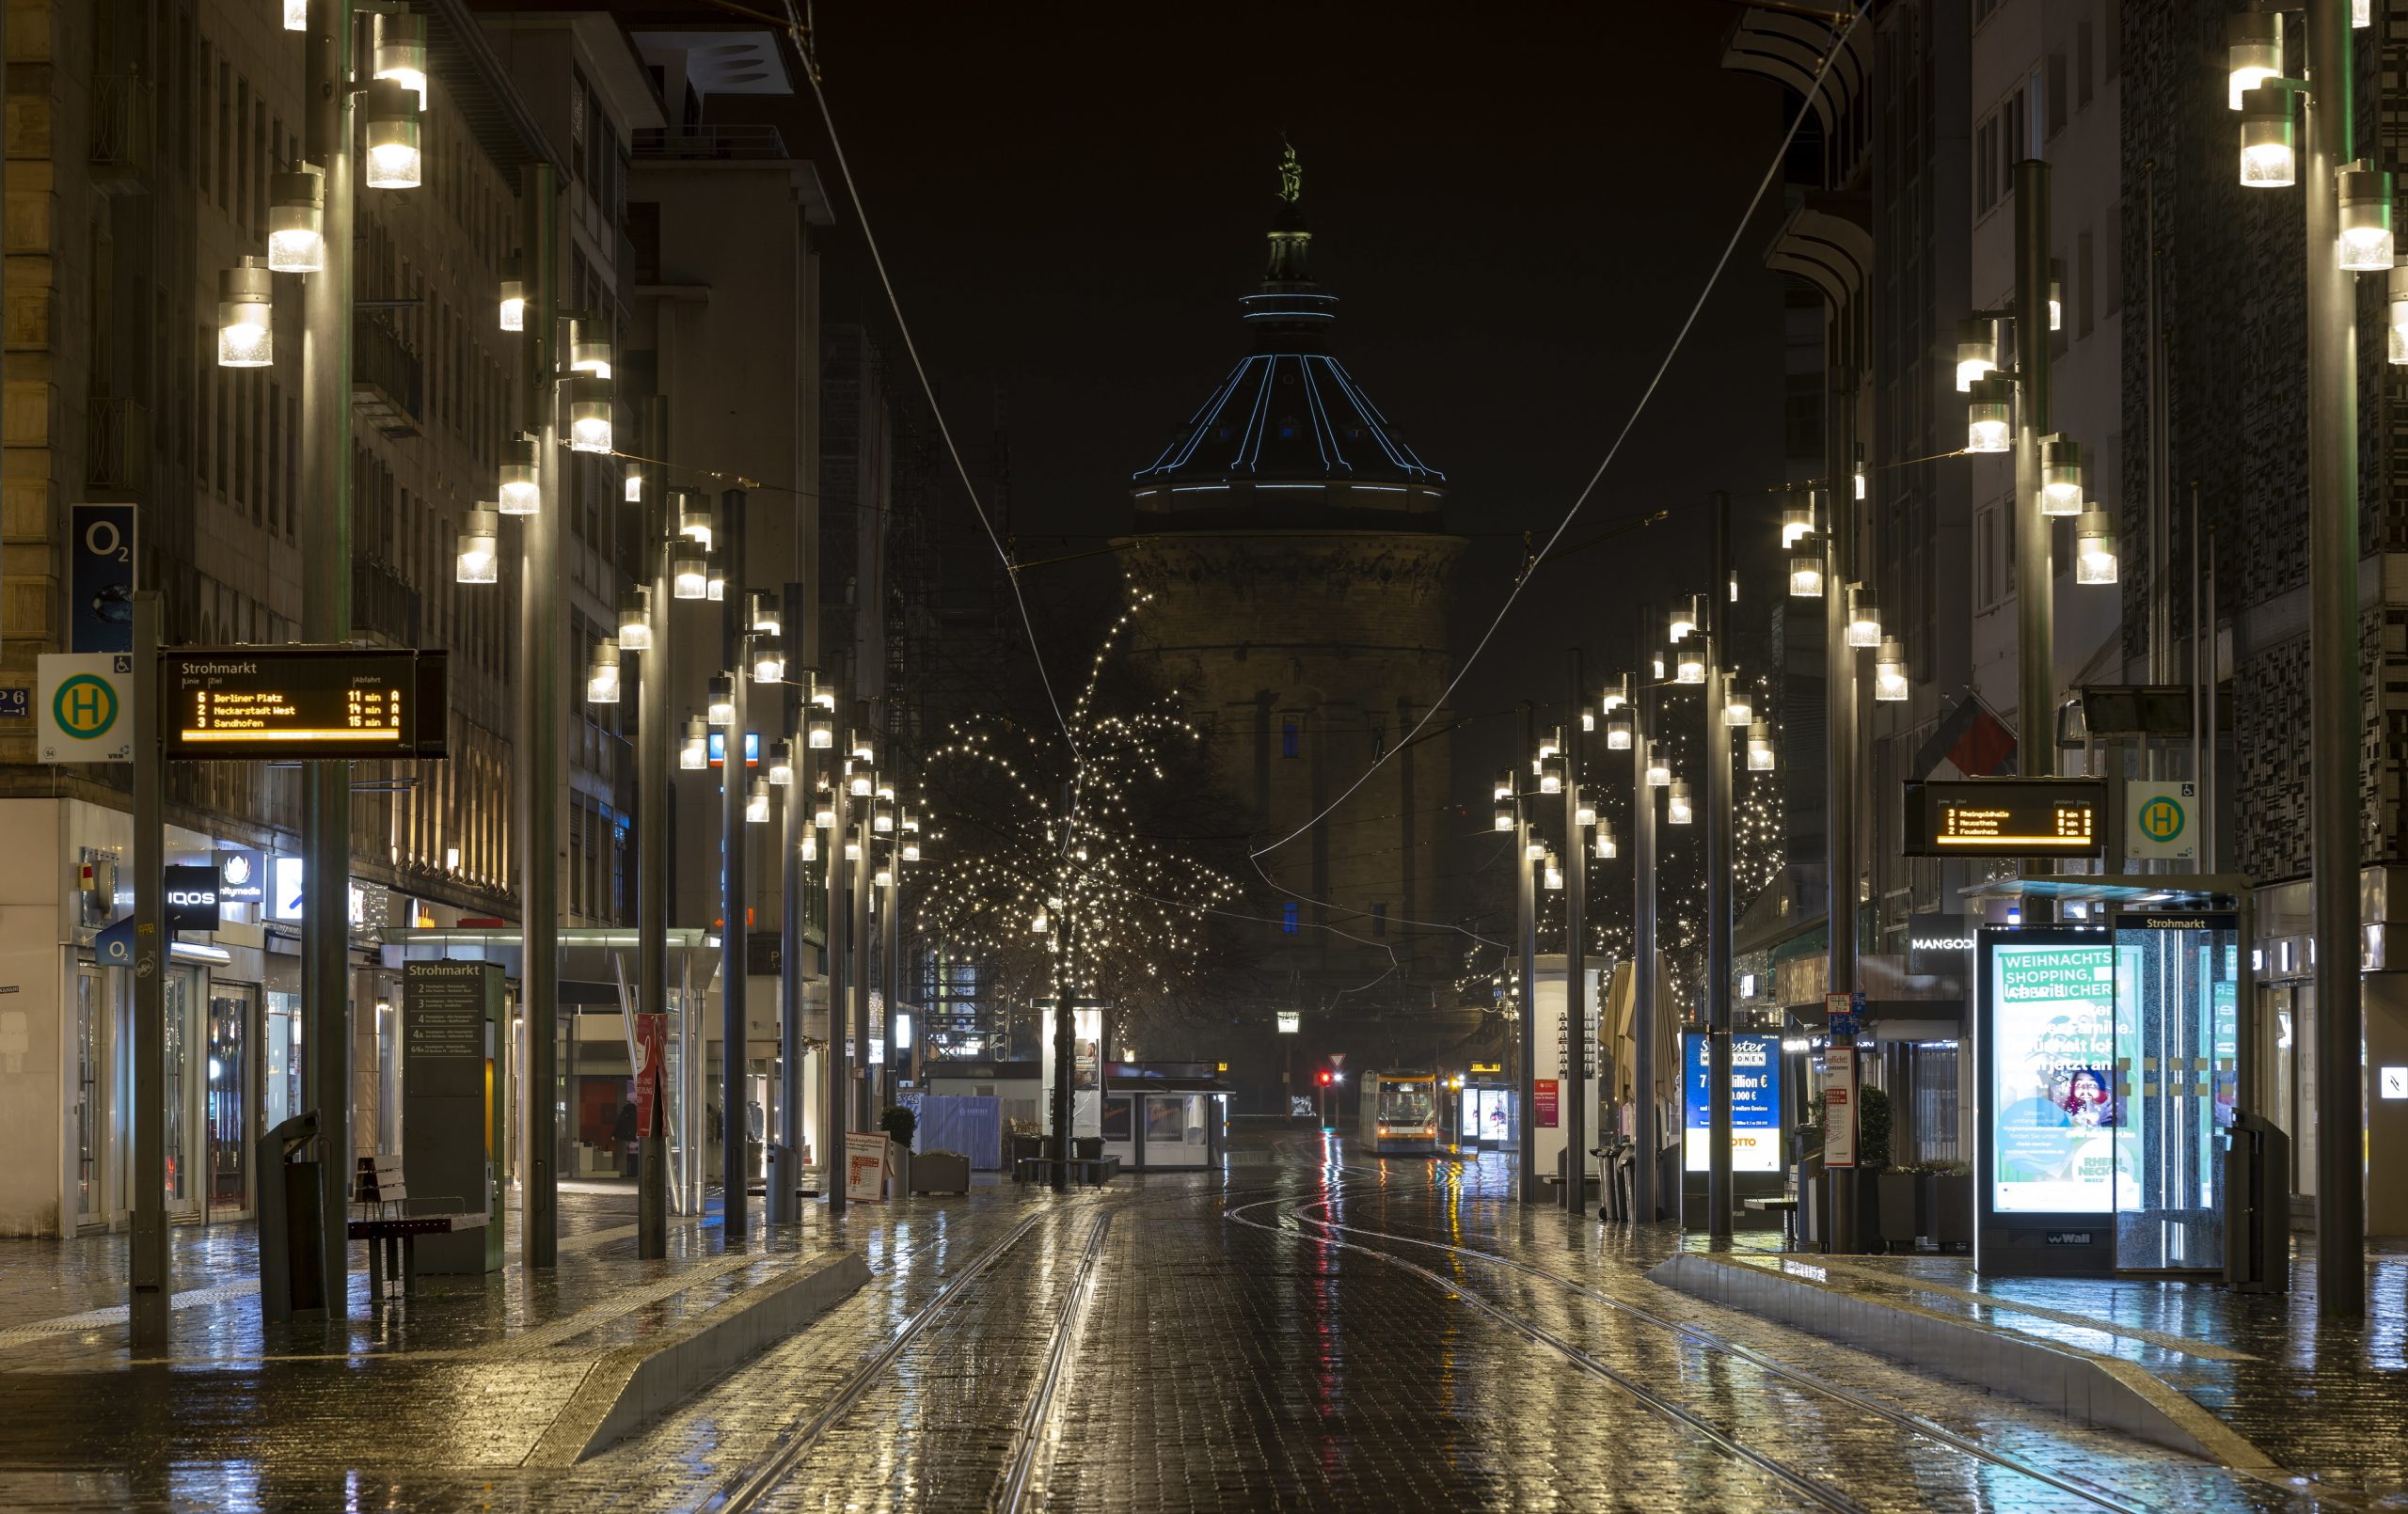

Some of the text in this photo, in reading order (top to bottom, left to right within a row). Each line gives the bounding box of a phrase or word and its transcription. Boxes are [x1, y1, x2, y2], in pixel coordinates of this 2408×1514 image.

[182, 661, 258, 675] Strohmarkt
[12, 690, 24, 705] 6
[198, 690, 400, 702] 6 Berliner Platz 11 min A
[198, 703, 400, 716] 2 Neckarstadt West 14 min A
[198, 716, 400, 728] 3 Sandhofen 15 min A
[1959, 811, 2010, 819] Rheingoldhalle
[167, 891, 215, 907] IQOS
[2147, 918, 2206, 929] Strohmarkt
[1912, 938, 1964, 950] MANGO
[408, 964, 481, 976] Strohmarkt
[2005, 968, 2092, 985] SHOPPING,
[418, 984, 424, 993] 2
[418, 999, 424, 1009] 3
[418, 1014, 424, 1024] 4
[1700, 1074, 1707, 1088] 7
[1760, 1074, 1768, 1088] €
[1731, 1138, 1757, 1147] OTTO
[2061, 1233, 2090, 1243] Wall
